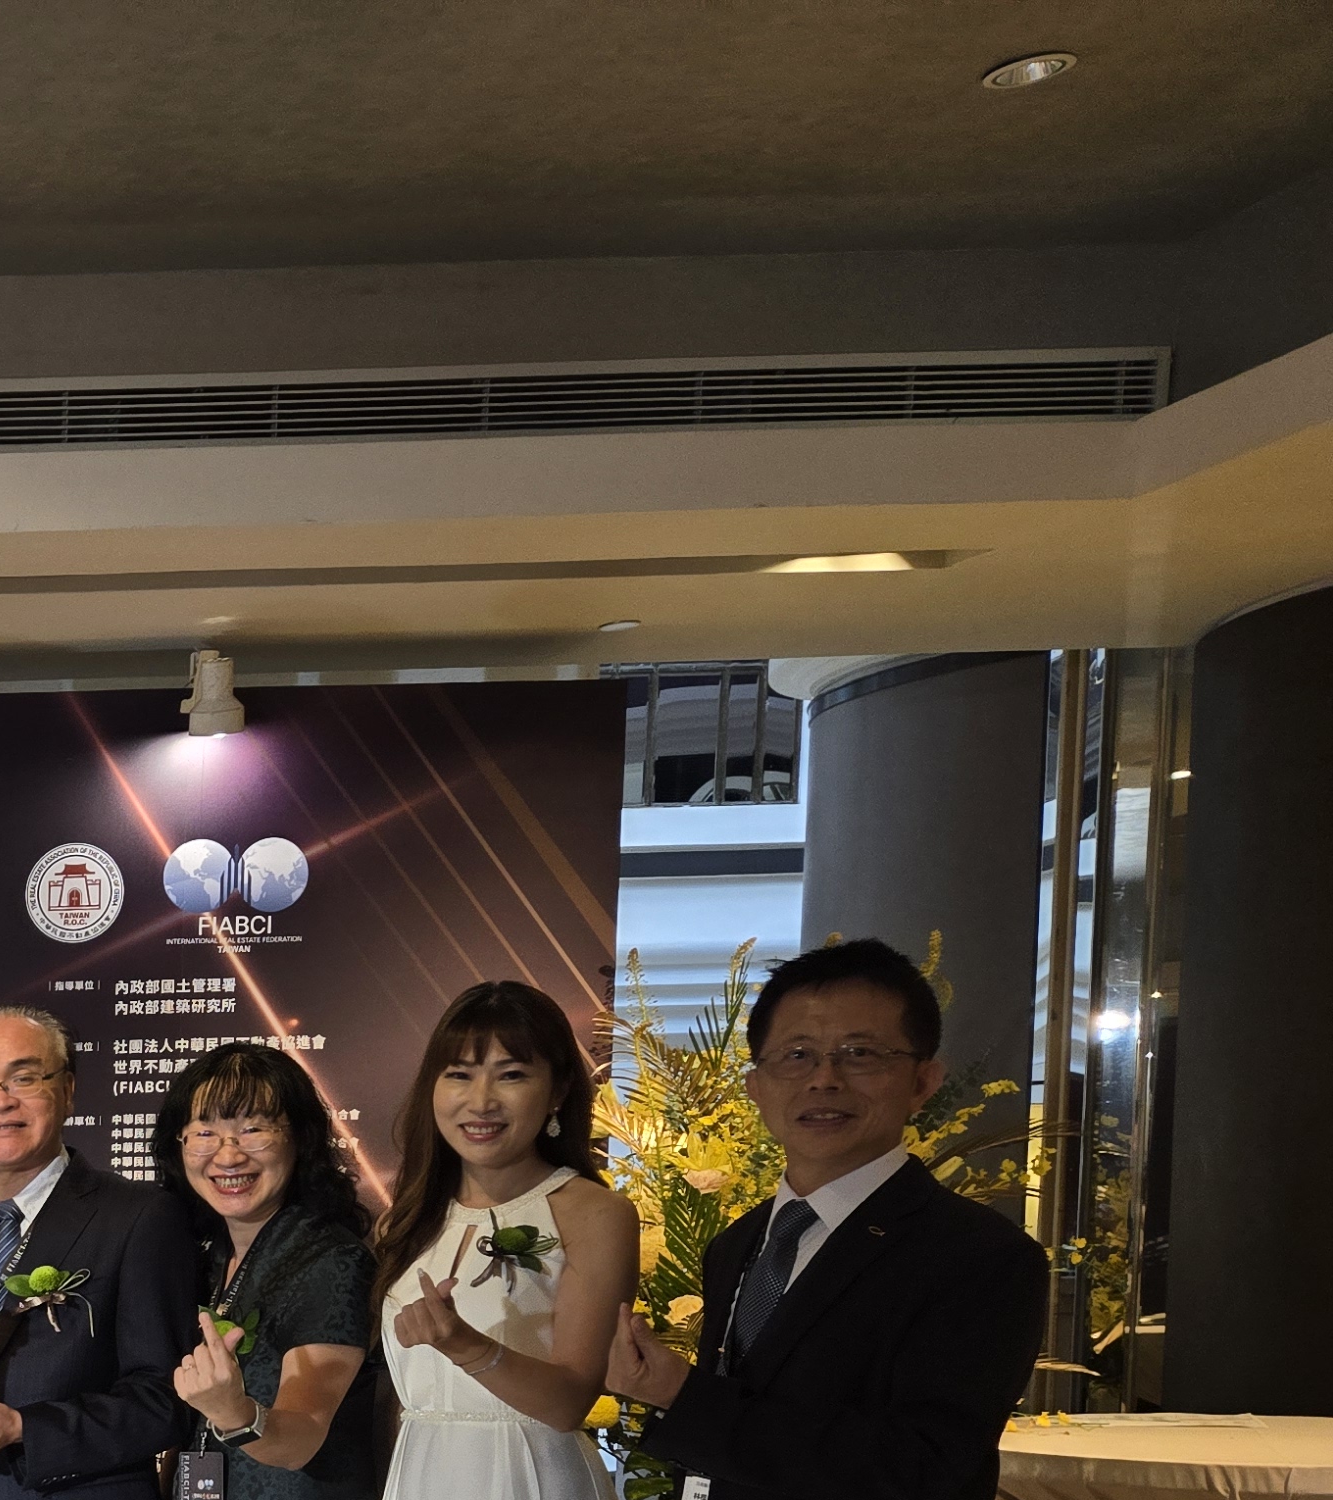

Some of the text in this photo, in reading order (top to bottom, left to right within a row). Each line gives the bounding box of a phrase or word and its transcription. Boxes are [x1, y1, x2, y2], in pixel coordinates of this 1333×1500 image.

[44, 847, 79, 865] ASSOCIATION
[198, 915, 272, 936] FIABCI
[166, 936, 218, 945] INTERNATIONAL
[237, 936, 261, 944] ESTATE
[262, 935, 303, 943] FEDERATION
[114, 977, 236, 995] 內政部國土管理署
[114, 998, 236, 1016] 內政部建築研究所
[74, 1041, 94, 1052] 單位
[113, 1059, 197, 1074] 世界不動產
[6, 1232, 31, 1272] FIABCI-T
